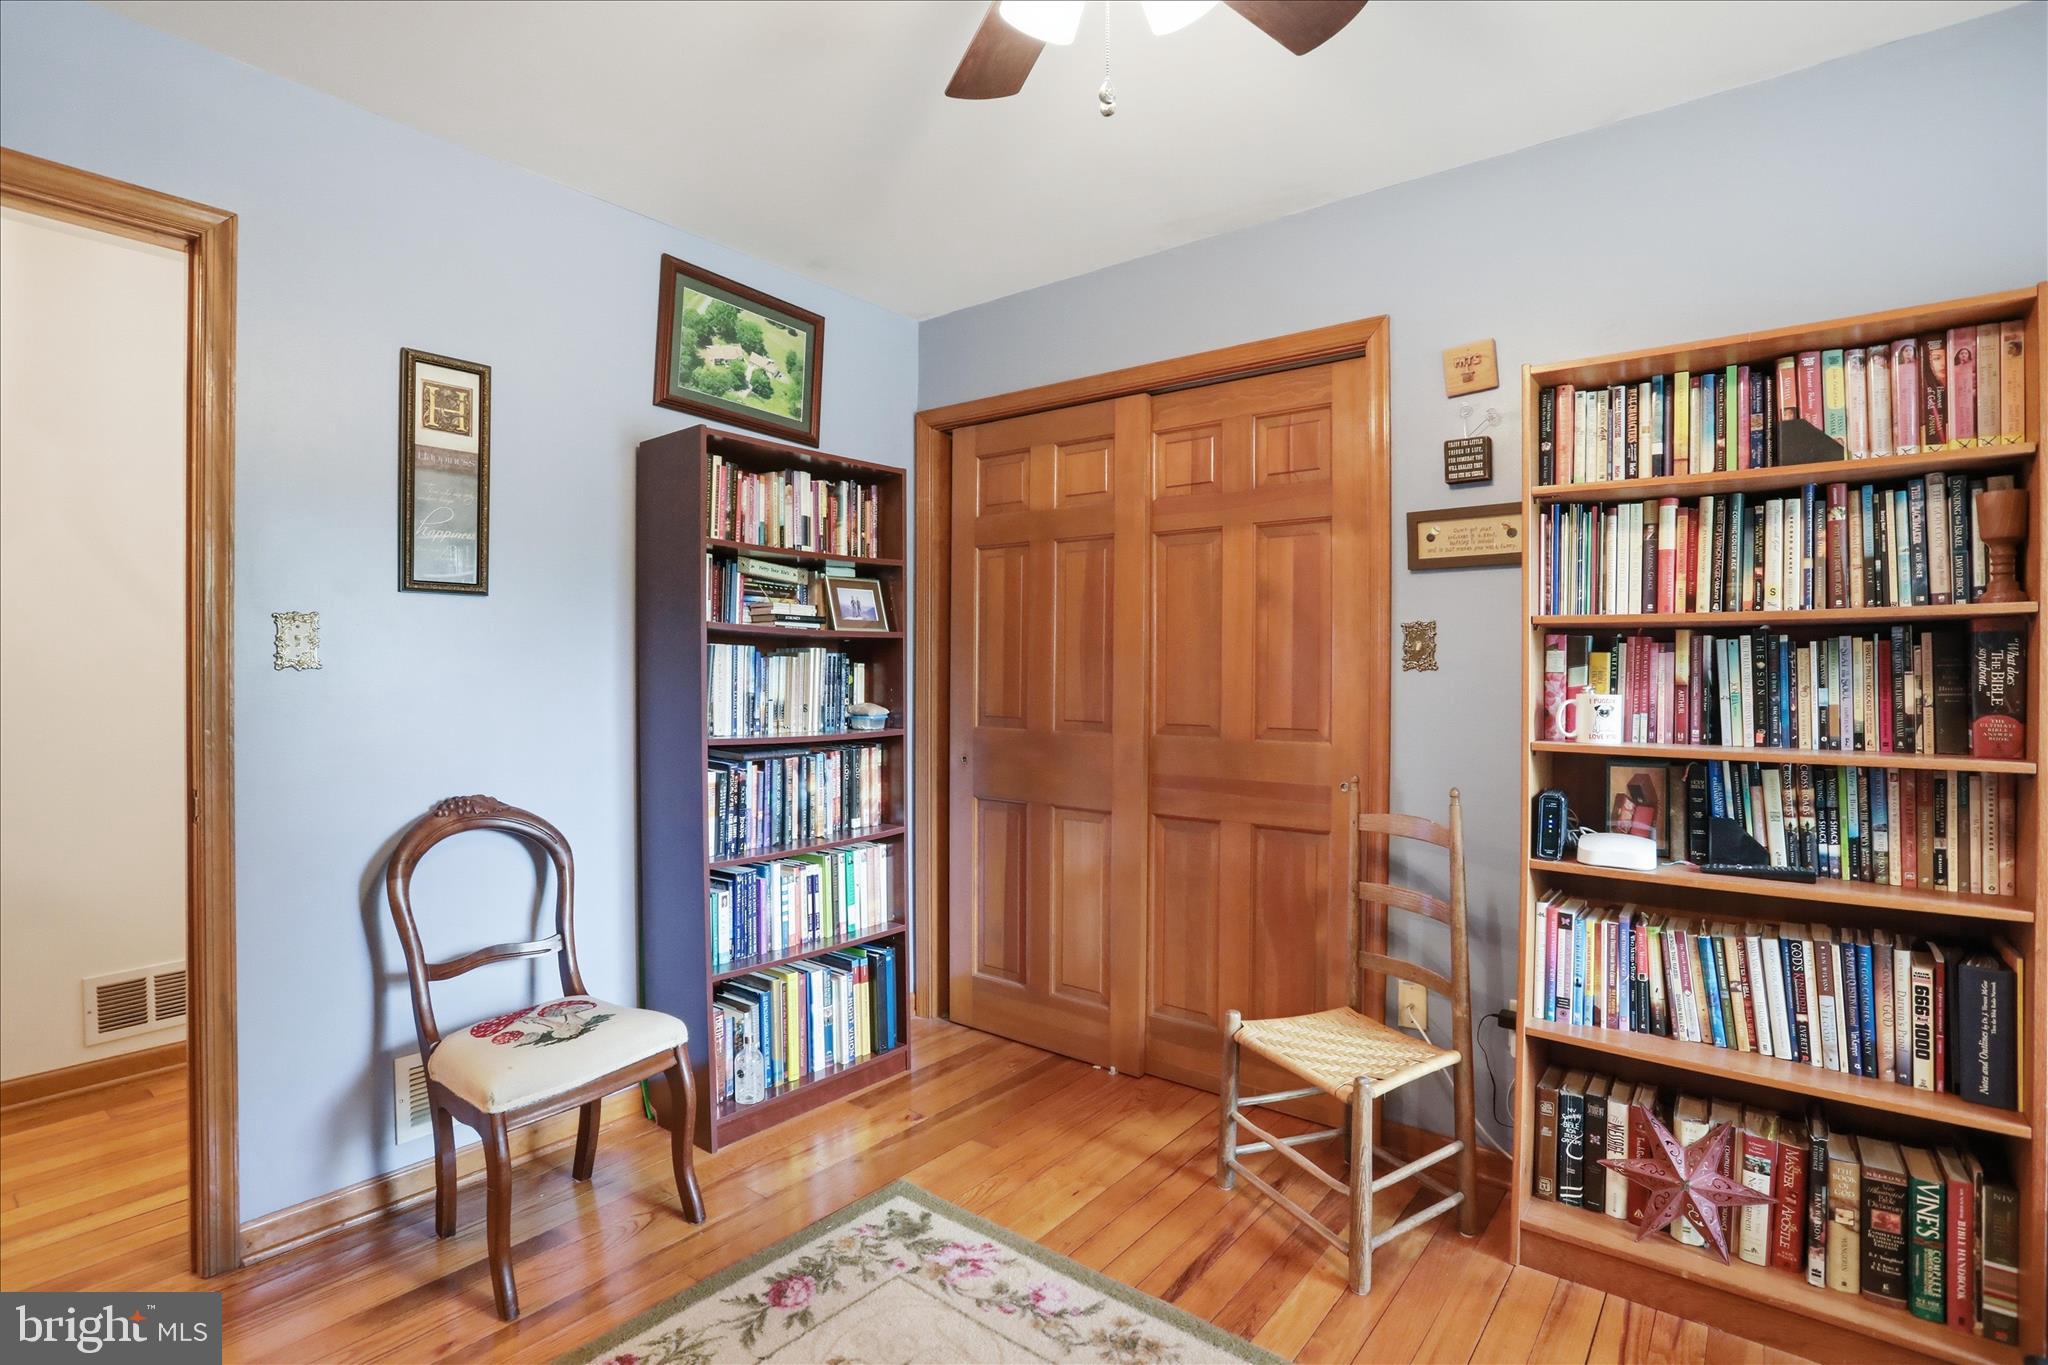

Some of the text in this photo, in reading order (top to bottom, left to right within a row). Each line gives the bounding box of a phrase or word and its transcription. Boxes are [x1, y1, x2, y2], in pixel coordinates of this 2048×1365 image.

[426, 386, 468, 432] H
[1953, 480, 1964, 548] STANDING ISRAEL
[1955, 555, 1964, 576] DAVID
[1756, 636, 1765, 696] THE SON
[1991, 650, 2005, 706] THE BIBLE
[2007, 667, 2019, 685] does
[1800, 764, 1810, 815] CROSS ROADS
[1790, 942, 1803, 971] GOD'S
[1794, 972, 1806, 1013] KINGDOM
[1860, 968, 1868, 985] GOD
[1897, 990, 1908, 1027] Darwin's
[1915, 985, 1930, 1060] 666 1000
[1800, 1025, 1808, 1054] EVERETT
[1978, 1060, 1989, 1076] and
[1978, 1076, 1989, 1095] Notes
[1608, 1122, 1624, 1155] MESSAGE
[1779, 1149, 1800, 1248] MASTER APOSTLE
[1814, 1192, 1822, 1207] IAN
[1833, 1188, 1856, 1198] GOD
[1917, 1184, 1940, 1239] VINE'S
[1993, 1193, 2014, 1203] NIV
[1933, 1250, 1942, 1297] COMPLETE
[1957, 1220, 1967, 1300] BIBLE HANDBOOK
